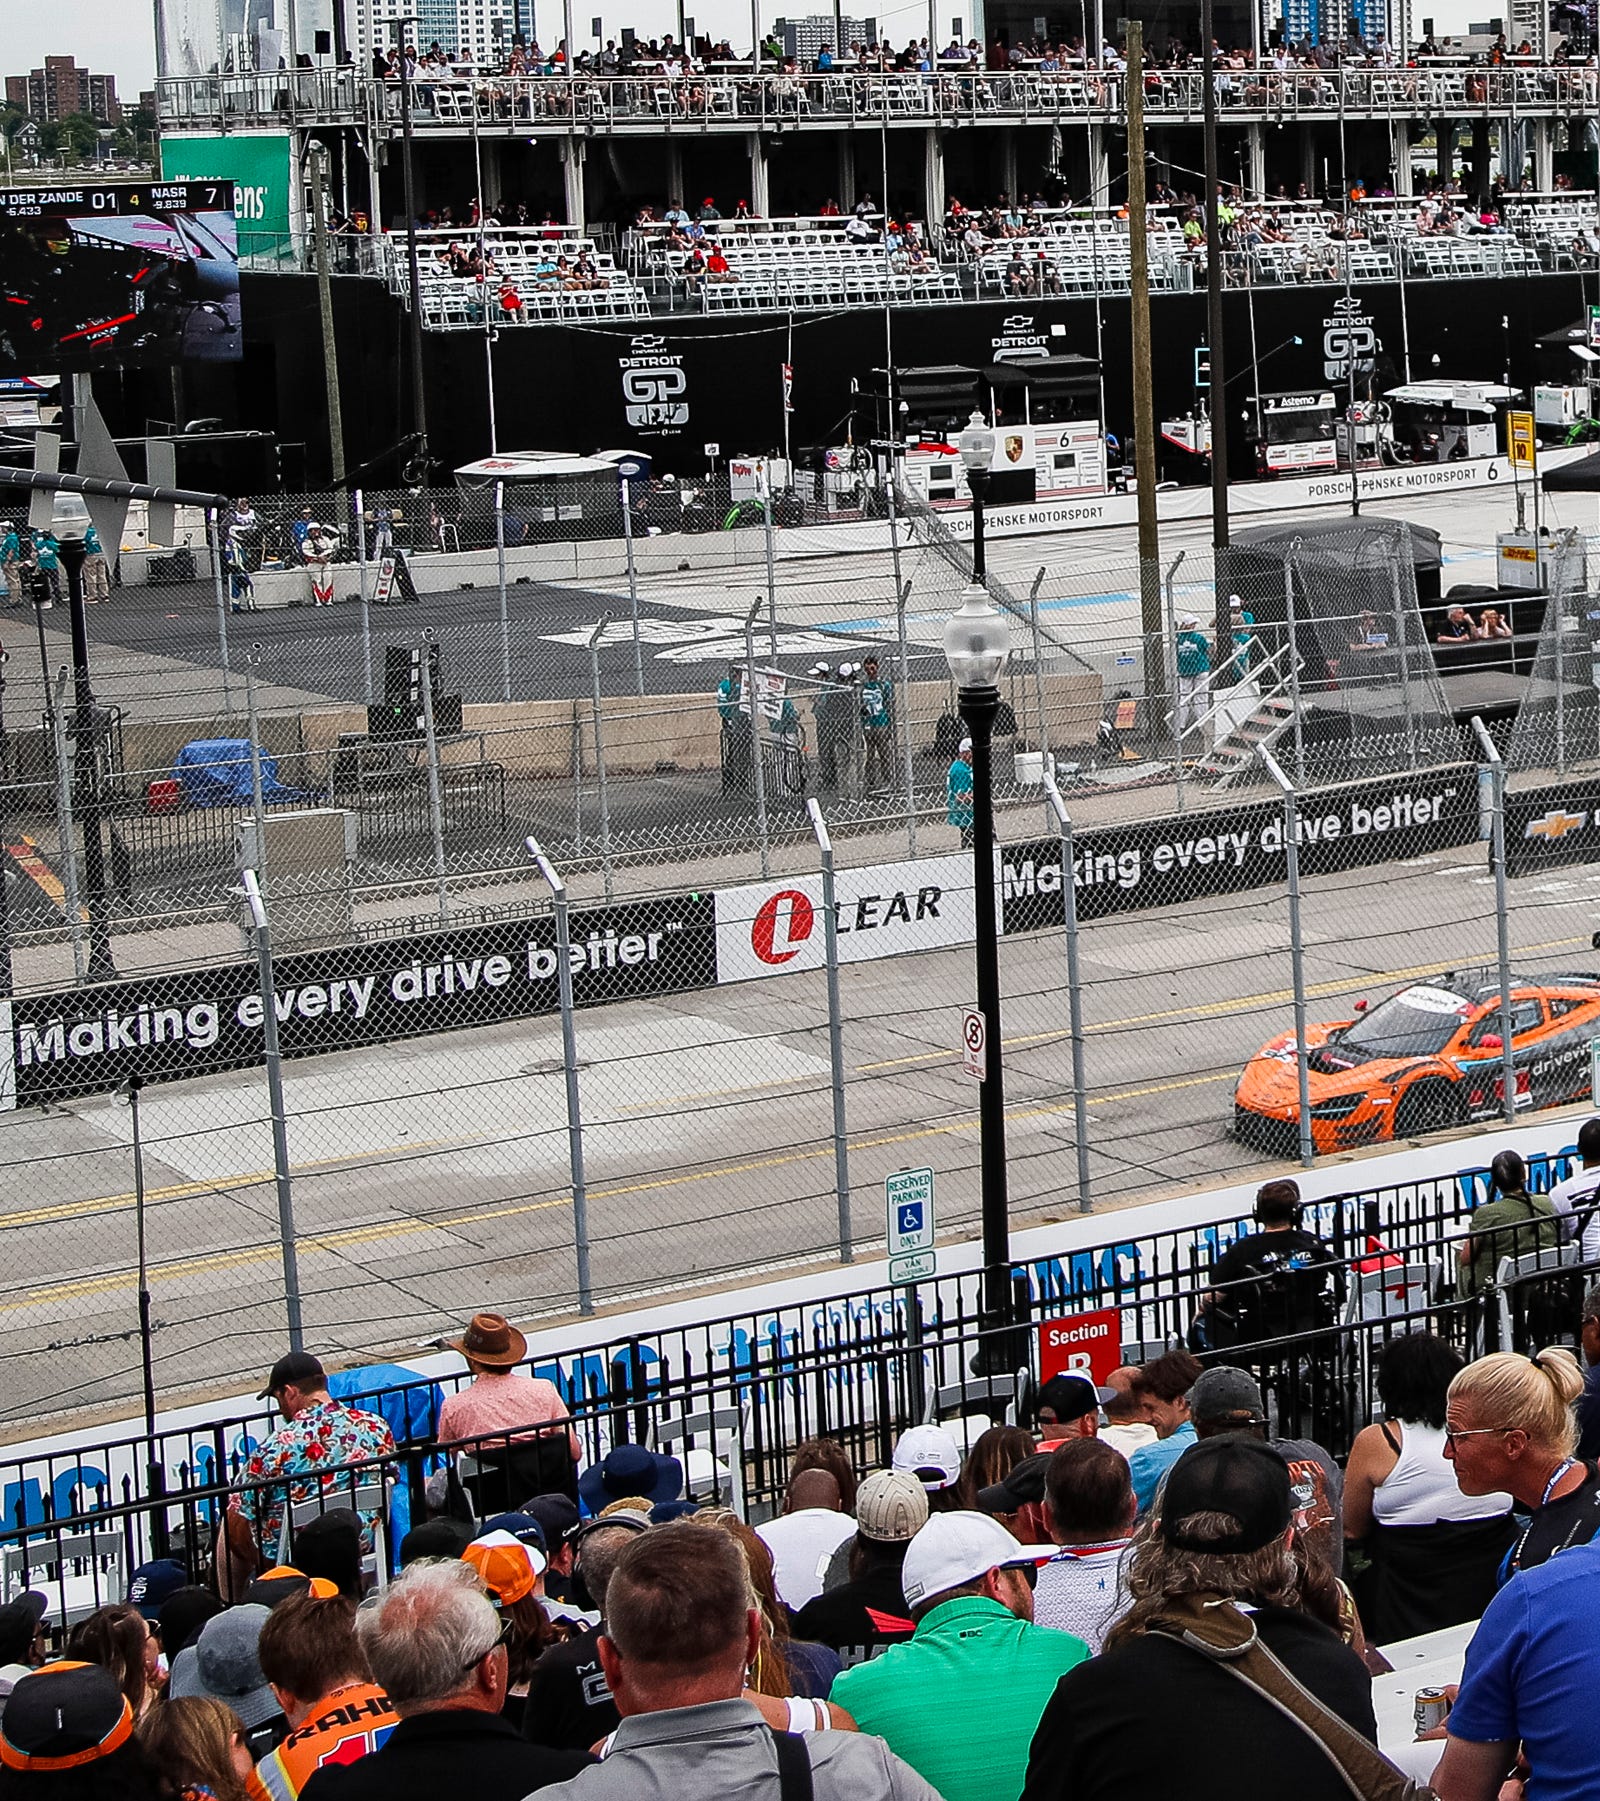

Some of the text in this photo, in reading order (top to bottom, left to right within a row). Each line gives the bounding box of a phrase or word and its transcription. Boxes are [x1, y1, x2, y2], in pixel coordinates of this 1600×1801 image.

[9, 193, 38, 206] DER
[41, 191, 84, 204] ZANDE
[92, 192, 117, 209] 01
[129, 194, 140, 206] 4
[151, 187, 188, 199] NASR
[205, 187, 218, 204] 7
[1323, 316, 1375, 328] DETROIT
[991, 335, 1049, 348] DETROIT
[1323, 327, 1375, 360] GP
[619, 355, 684, 368] DETROIT
[622, 367, 687, 403] GP
[1281, 396, 1315, 407] Astemo
[1059, 431, 1070, 448] 6
[1515, 443, 1527, 460] 10
[1308, 479, 1356, 497] PORSCH
[1406, 467, 1477, 486] MOTORSPORT
[1487, 461, 1499, 480] 6
[983, 513, 1027, 529] PENSKE
[1029, 506, 1104, 524] MOTORSPORT
[1002, 846, 1142, 899] Making
[1152, 824, 1250, 874] every
[836, 885, 943, 935] LEAR
[19, 999, 219, 1066] Making
[237, 974, 376, 1029] every
[392, 952, 512, 1000] drive
[888, 1173, 931, 1193] RESERVED
[891, 1187, 929, 1205] PARKING
[900, 1233, 922, 1248] ONLY
[904, 1258, 922, 1269] VAN
[1049, 1322, 1109, 1347] Section
